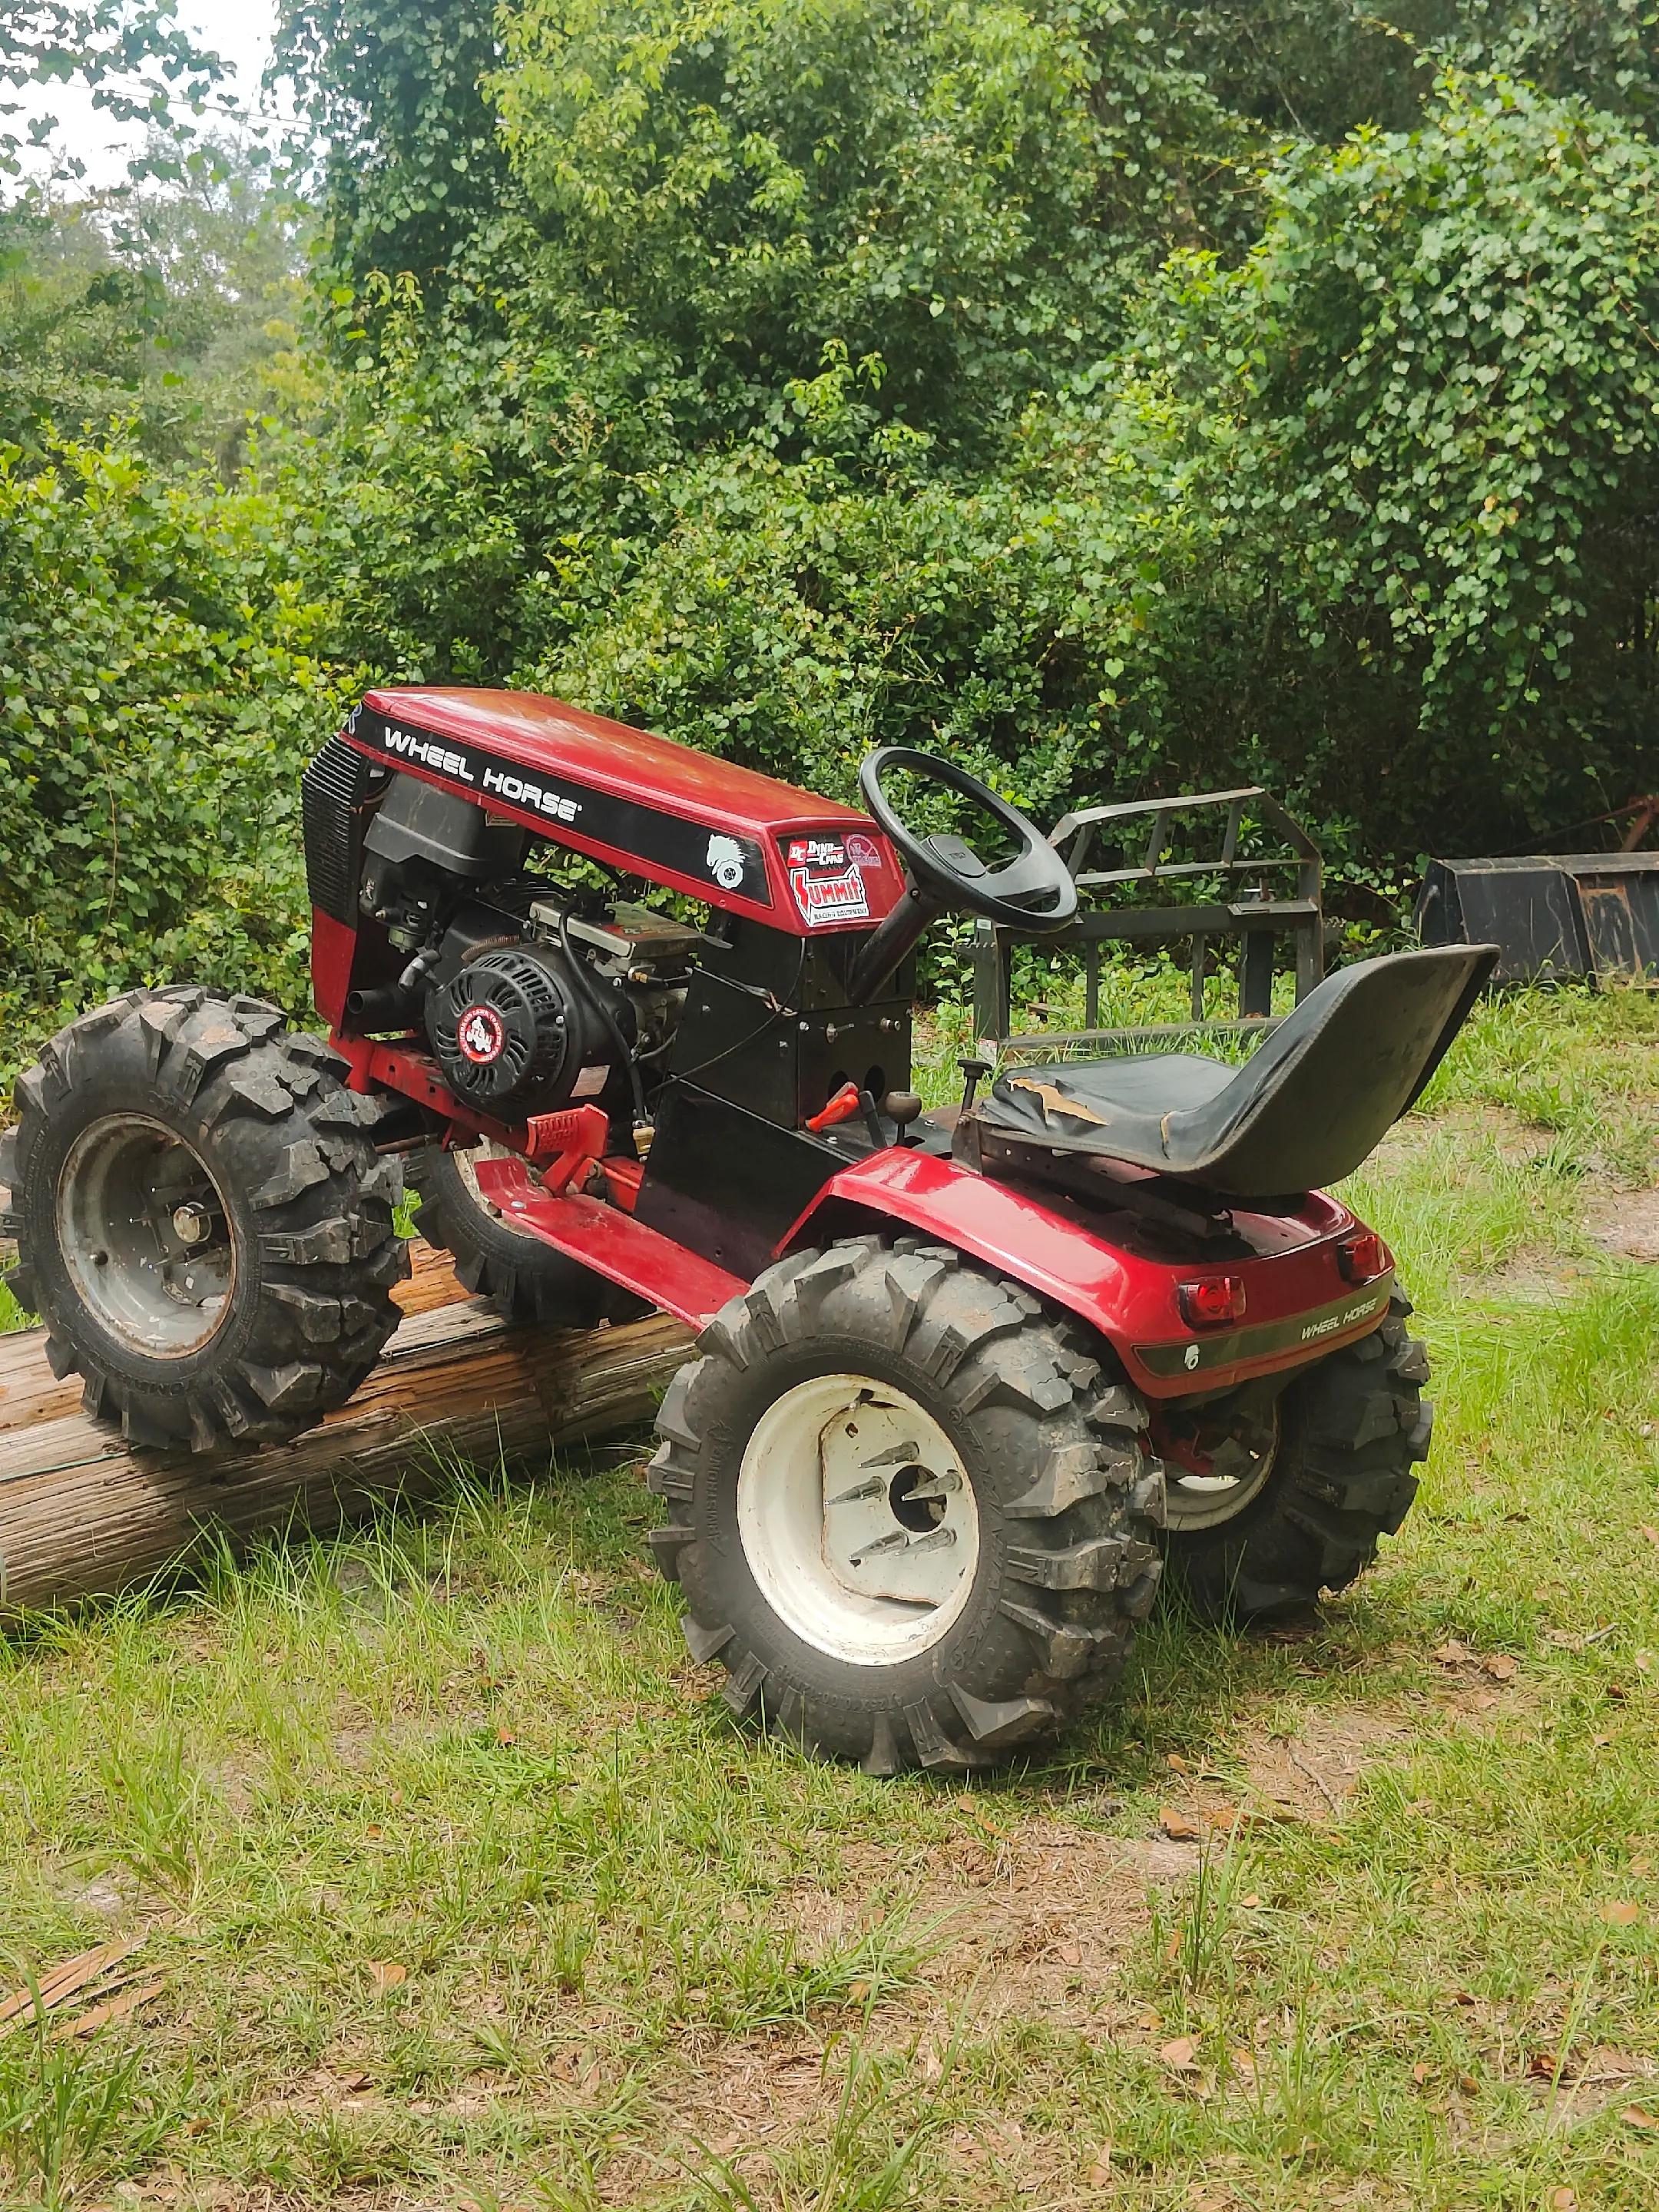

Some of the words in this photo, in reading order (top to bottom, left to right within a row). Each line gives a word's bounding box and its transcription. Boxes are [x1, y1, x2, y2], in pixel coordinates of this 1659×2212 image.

[384, 726, 474, 782] WHEEL
[482, 767, 578, 823] HORSE
[790, 846, 805, 861] DC
[1301, 1316, 1340, 1340] WHEEL
[1343, 1297, 1378, 1324] HORSE
